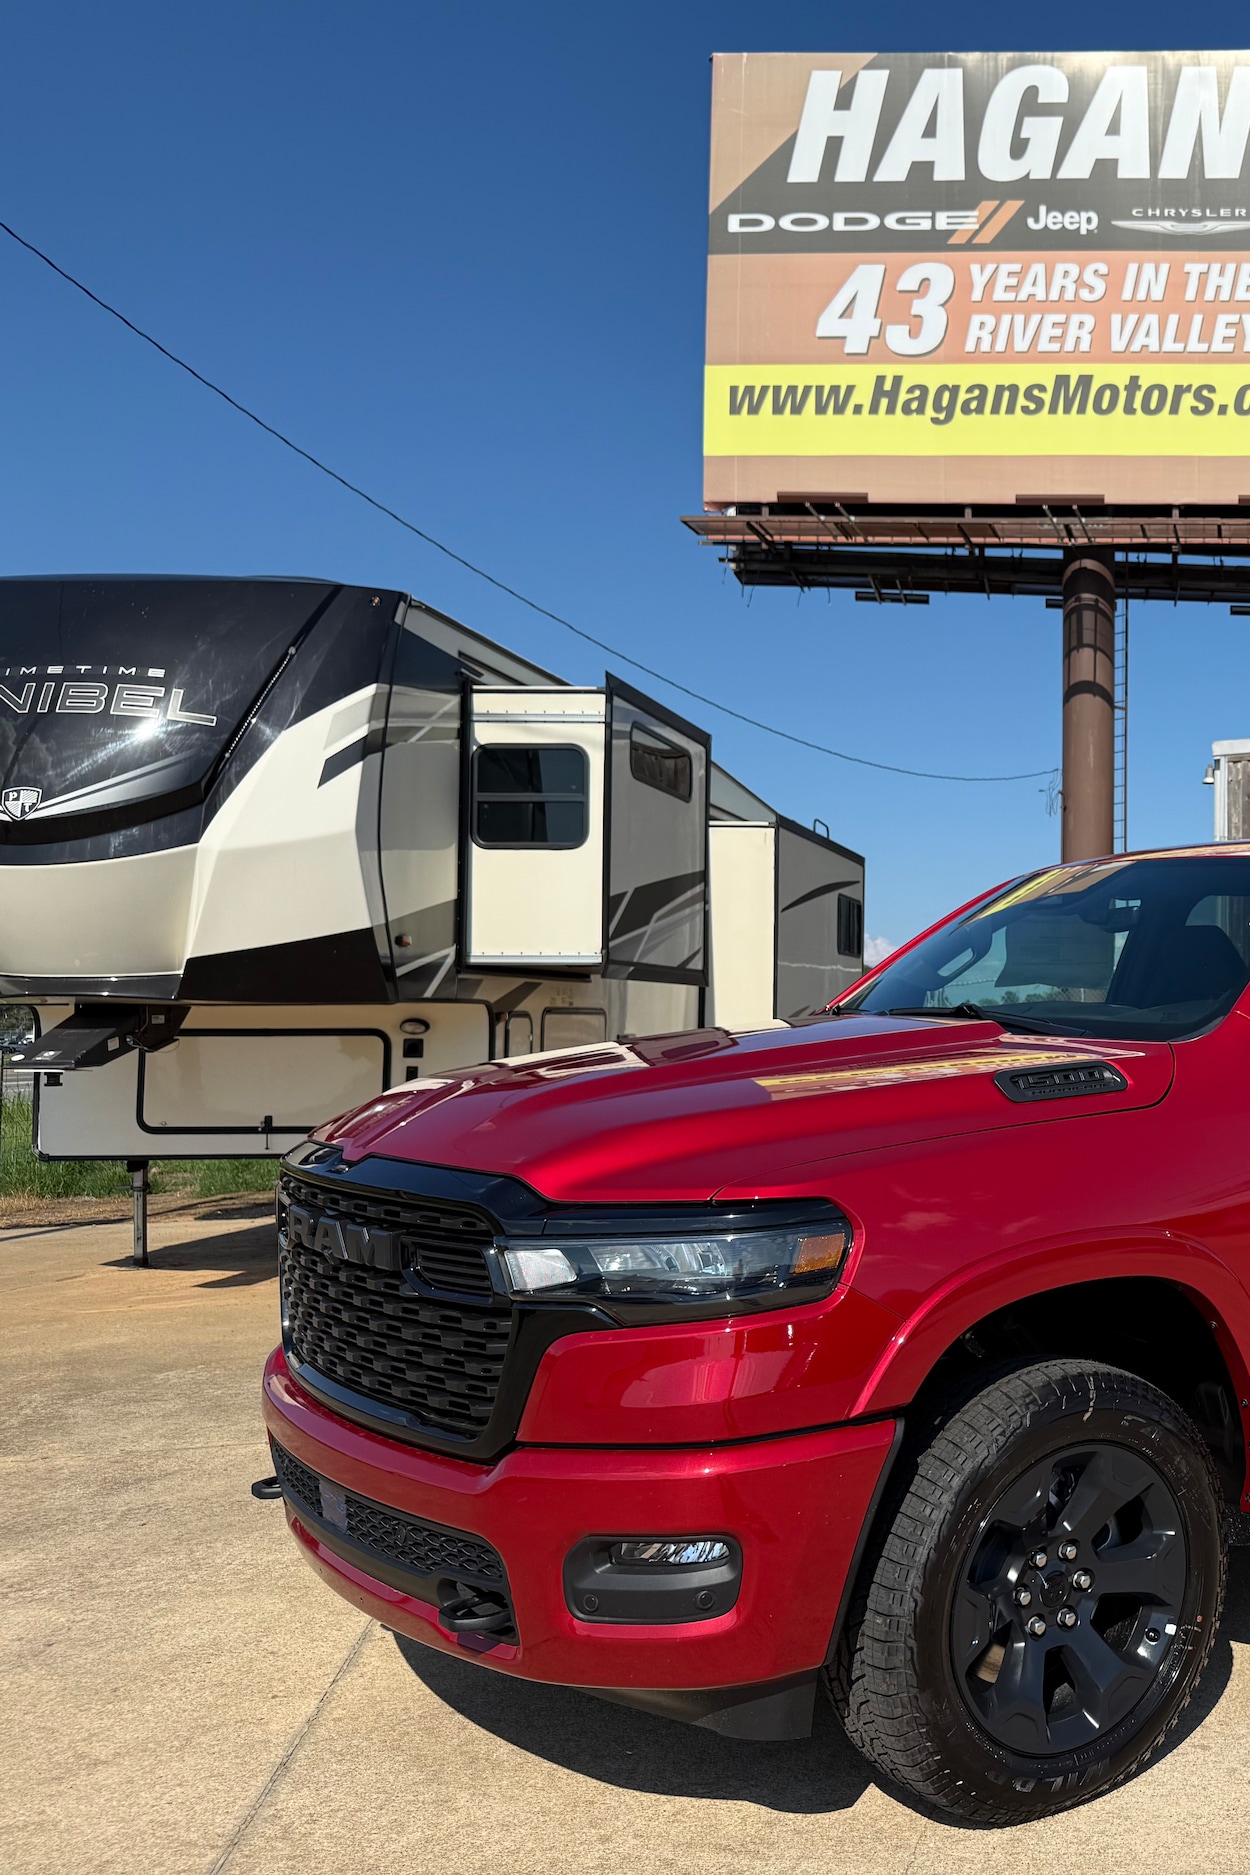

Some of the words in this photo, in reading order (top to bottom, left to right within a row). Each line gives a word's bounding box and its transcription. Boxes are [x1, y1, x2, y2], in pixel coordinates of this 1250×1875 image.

[727, 210, 980, 233] DODGE
[1026, 204, 1098, 235] Jeep
[1131, 206, 1248, 218] CHRYSLER
[969, 262, 1109, 302] YEARS
[1121, 262, 1171, 302] IN
[815, 262, 955, 356] 43
[965, 313, 1094, 353] RIVER
[1011, 1070, 1105, 1090] 1500
[289, 1204, 393, 1271] RAM
